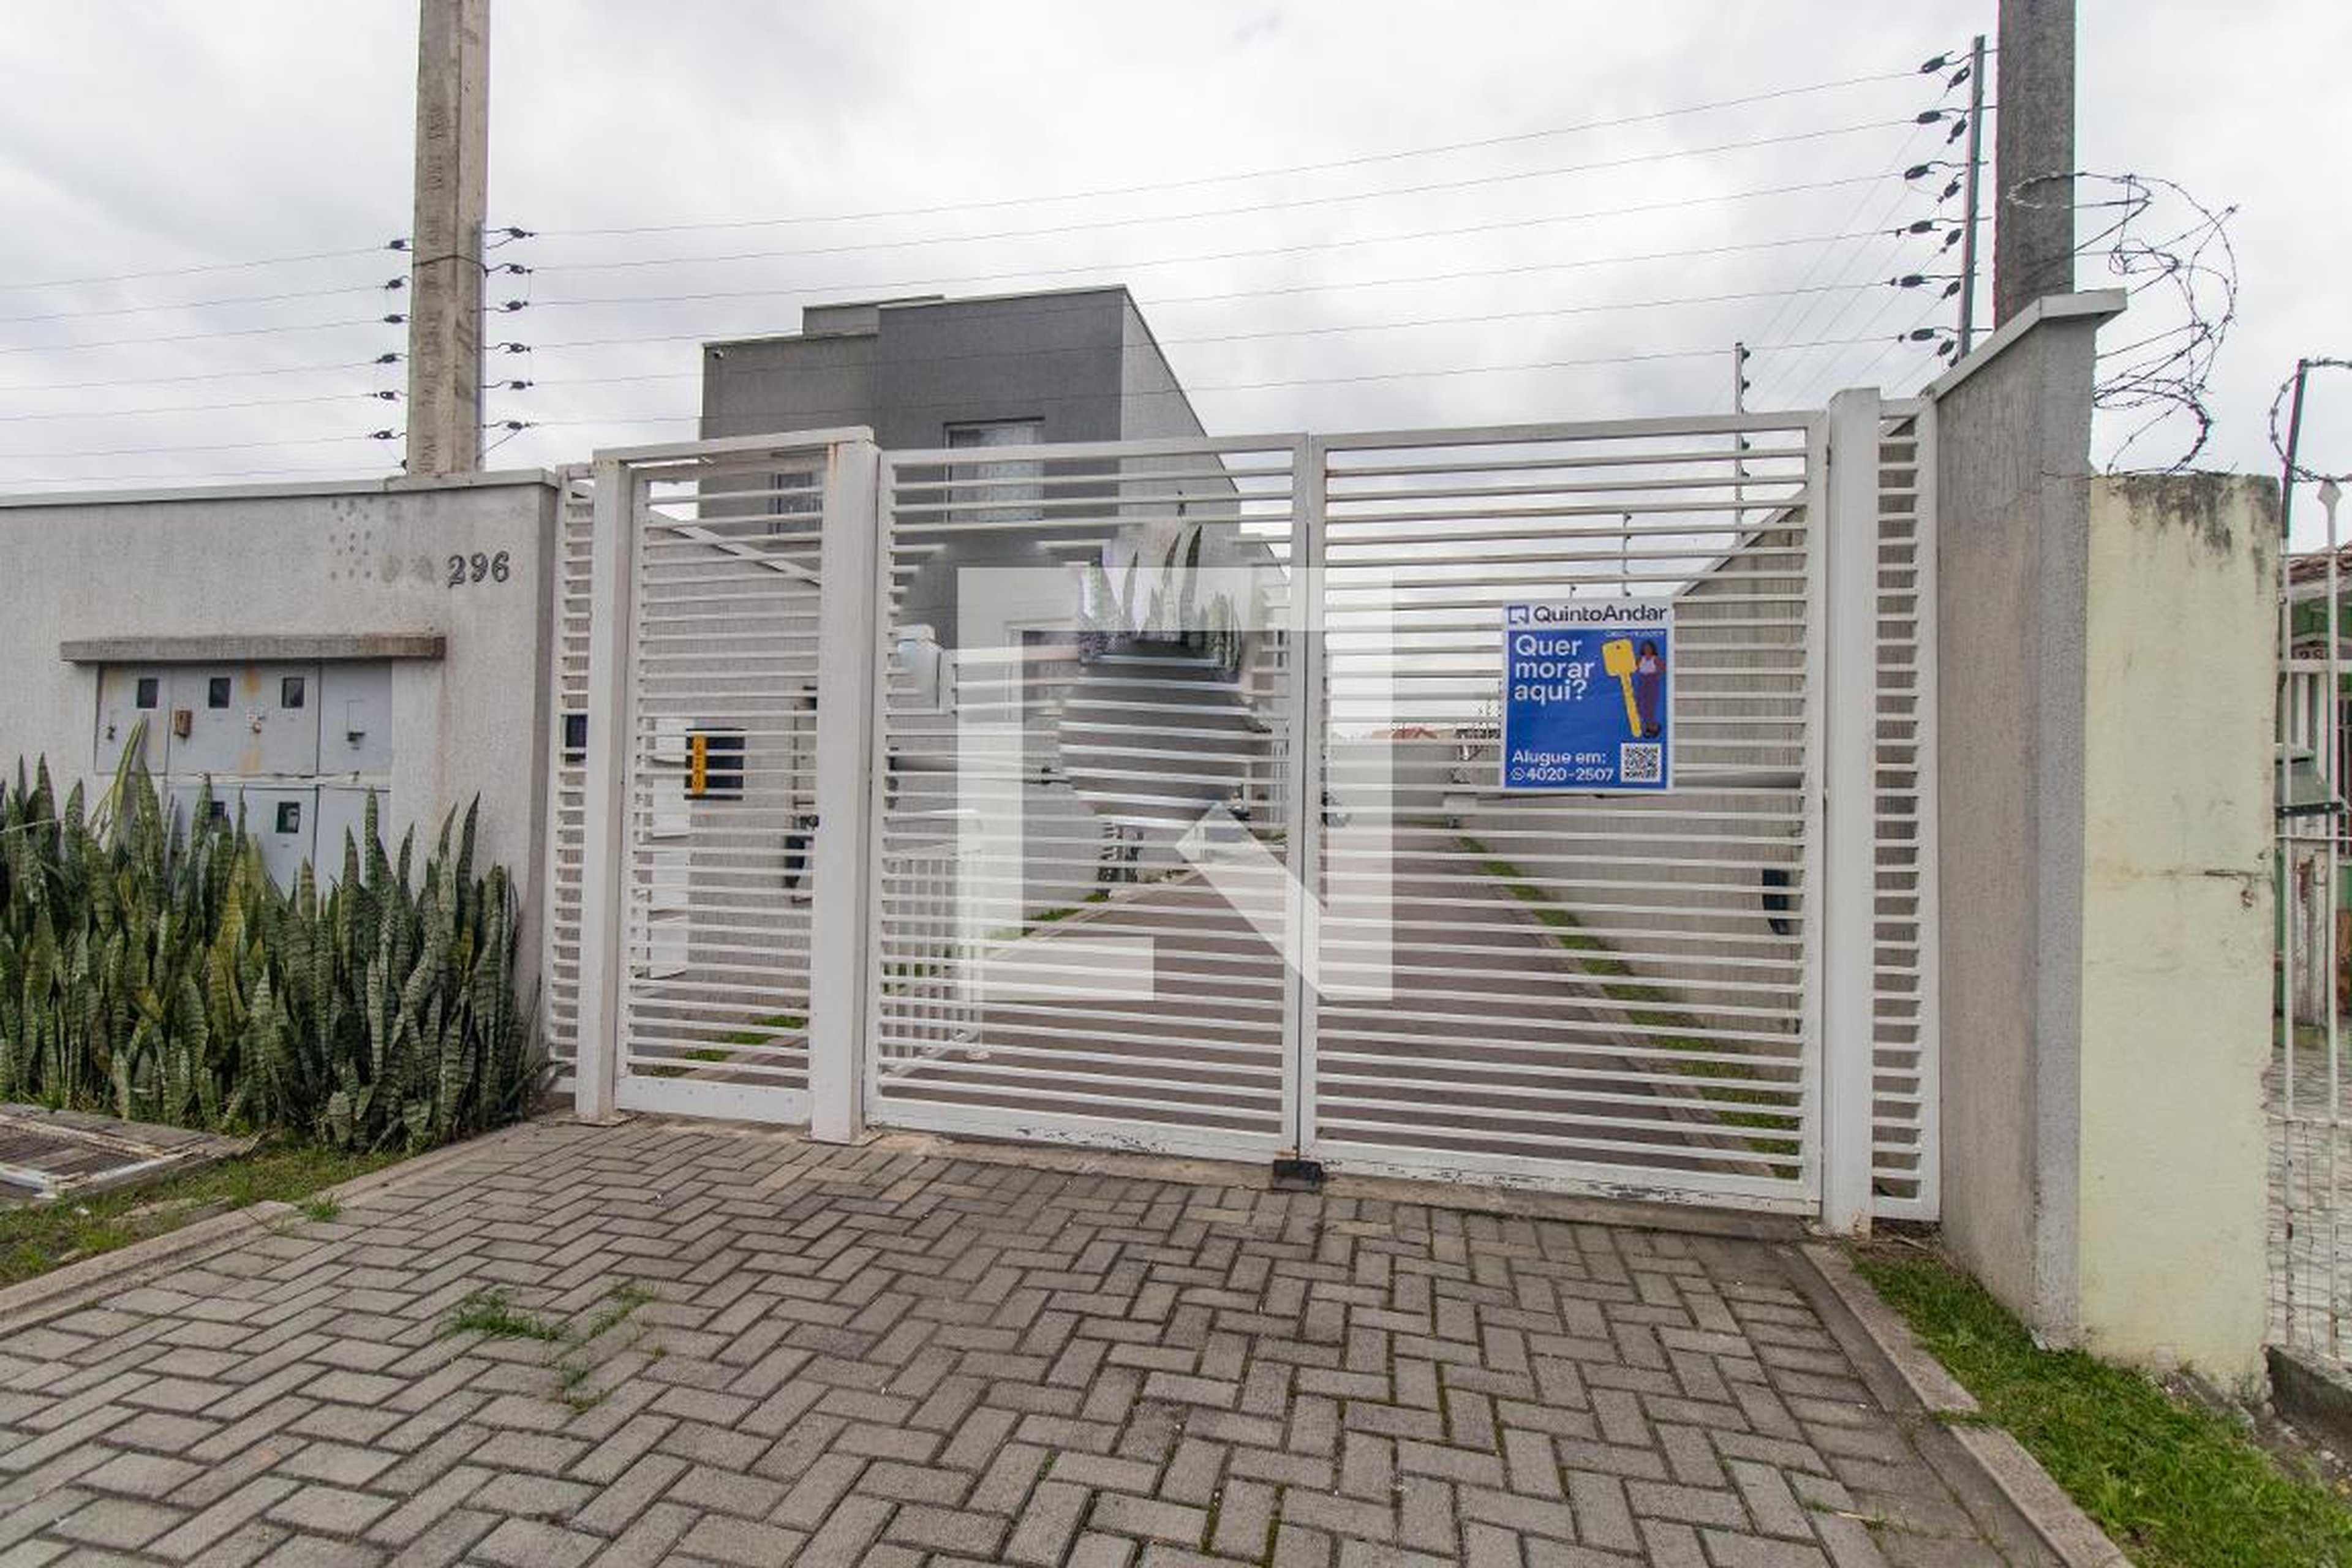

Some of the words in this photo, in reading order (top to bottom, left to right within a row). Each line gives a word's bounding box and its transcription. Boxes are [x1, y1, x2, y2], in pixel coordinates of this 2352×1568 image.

[447, 551, 510, 589] 296
[1533, 604, 1667, 623] QuintoAndar
[1516, 635, 1582, 656] Quer
[1515, 662, 1595, 678] morar
[1514, 679, 1588, 706] aqui?
[1512, 750, 1572, 766] Alugue
[1575, 753, 1607, 764] em:
[1526, 767, 1614, 782] 4020-2507
